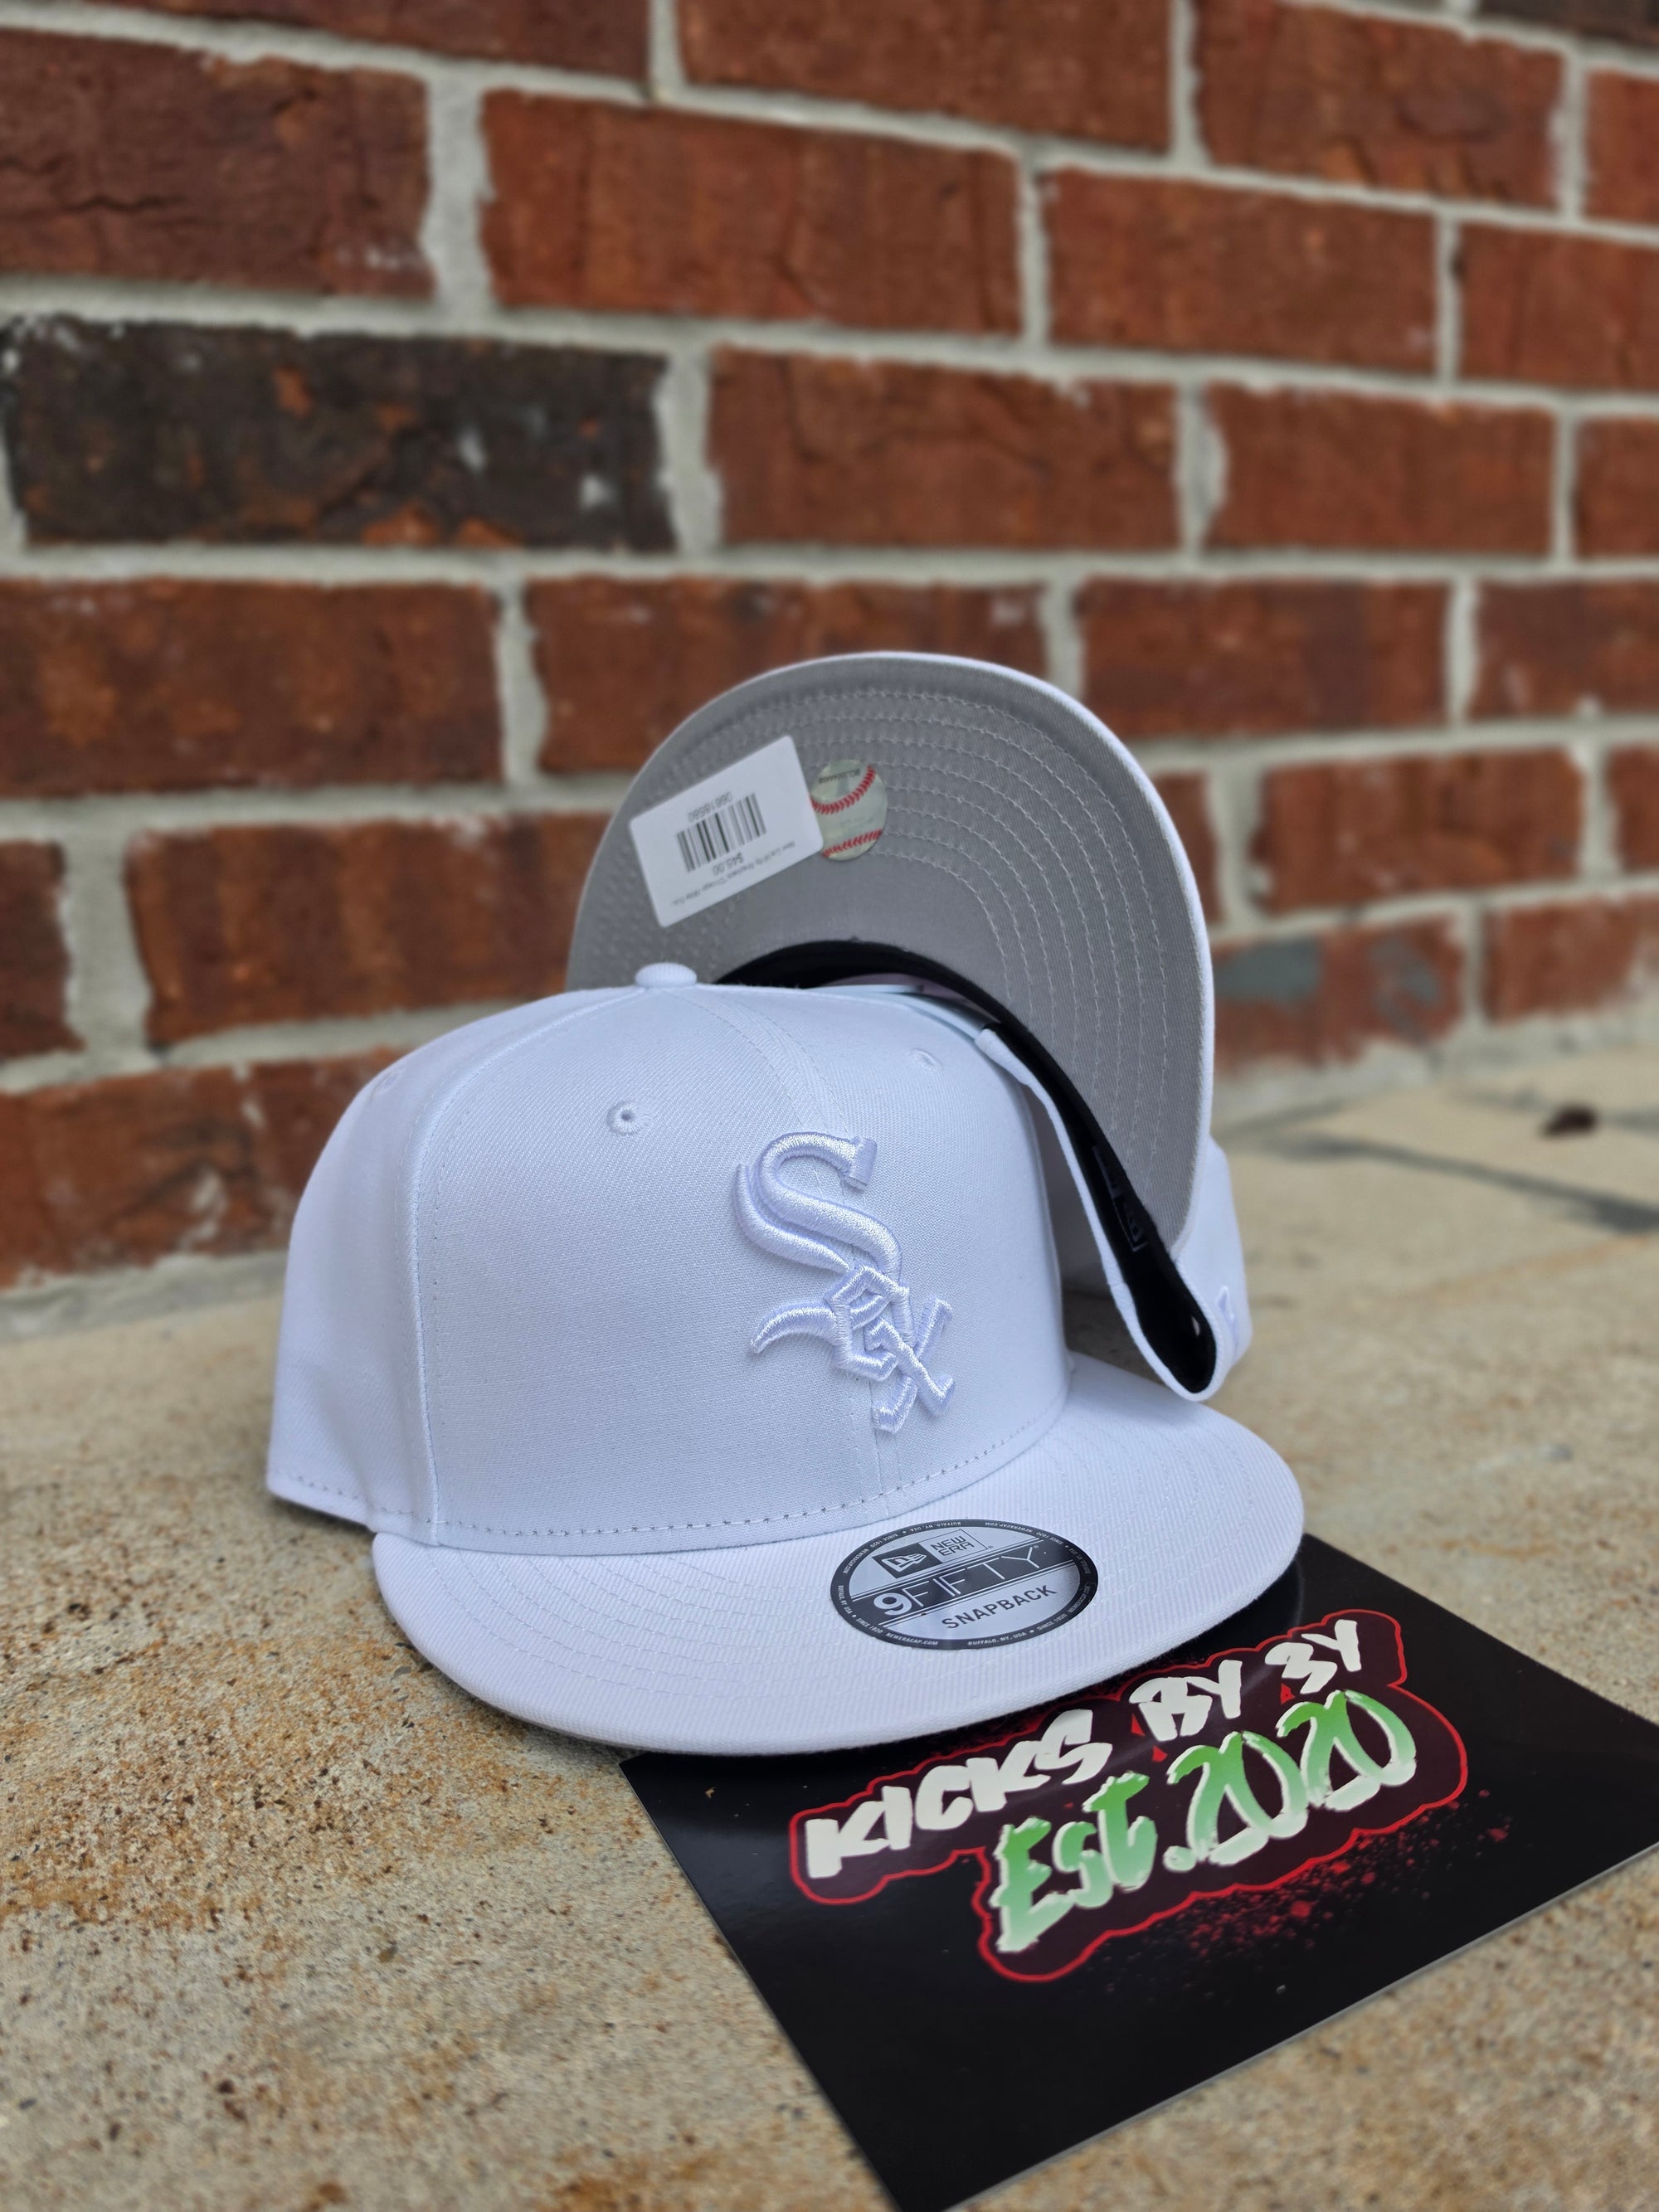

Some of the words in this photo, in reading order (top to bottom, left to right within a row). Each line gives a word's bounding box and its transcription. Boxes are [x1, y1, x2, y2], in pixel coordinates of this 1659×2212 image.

[930, 1535, 966, 1551] NEW
[938, 1541, 975, 1556] ERA
[873, 1547, 1040, 1616] 9FIFTY
[941, 1584, 1058, 1629] SNAPBACK
[805, 1709, 1113, 1879] KICKS
[1129, 1660, 1243, 1742] BY
